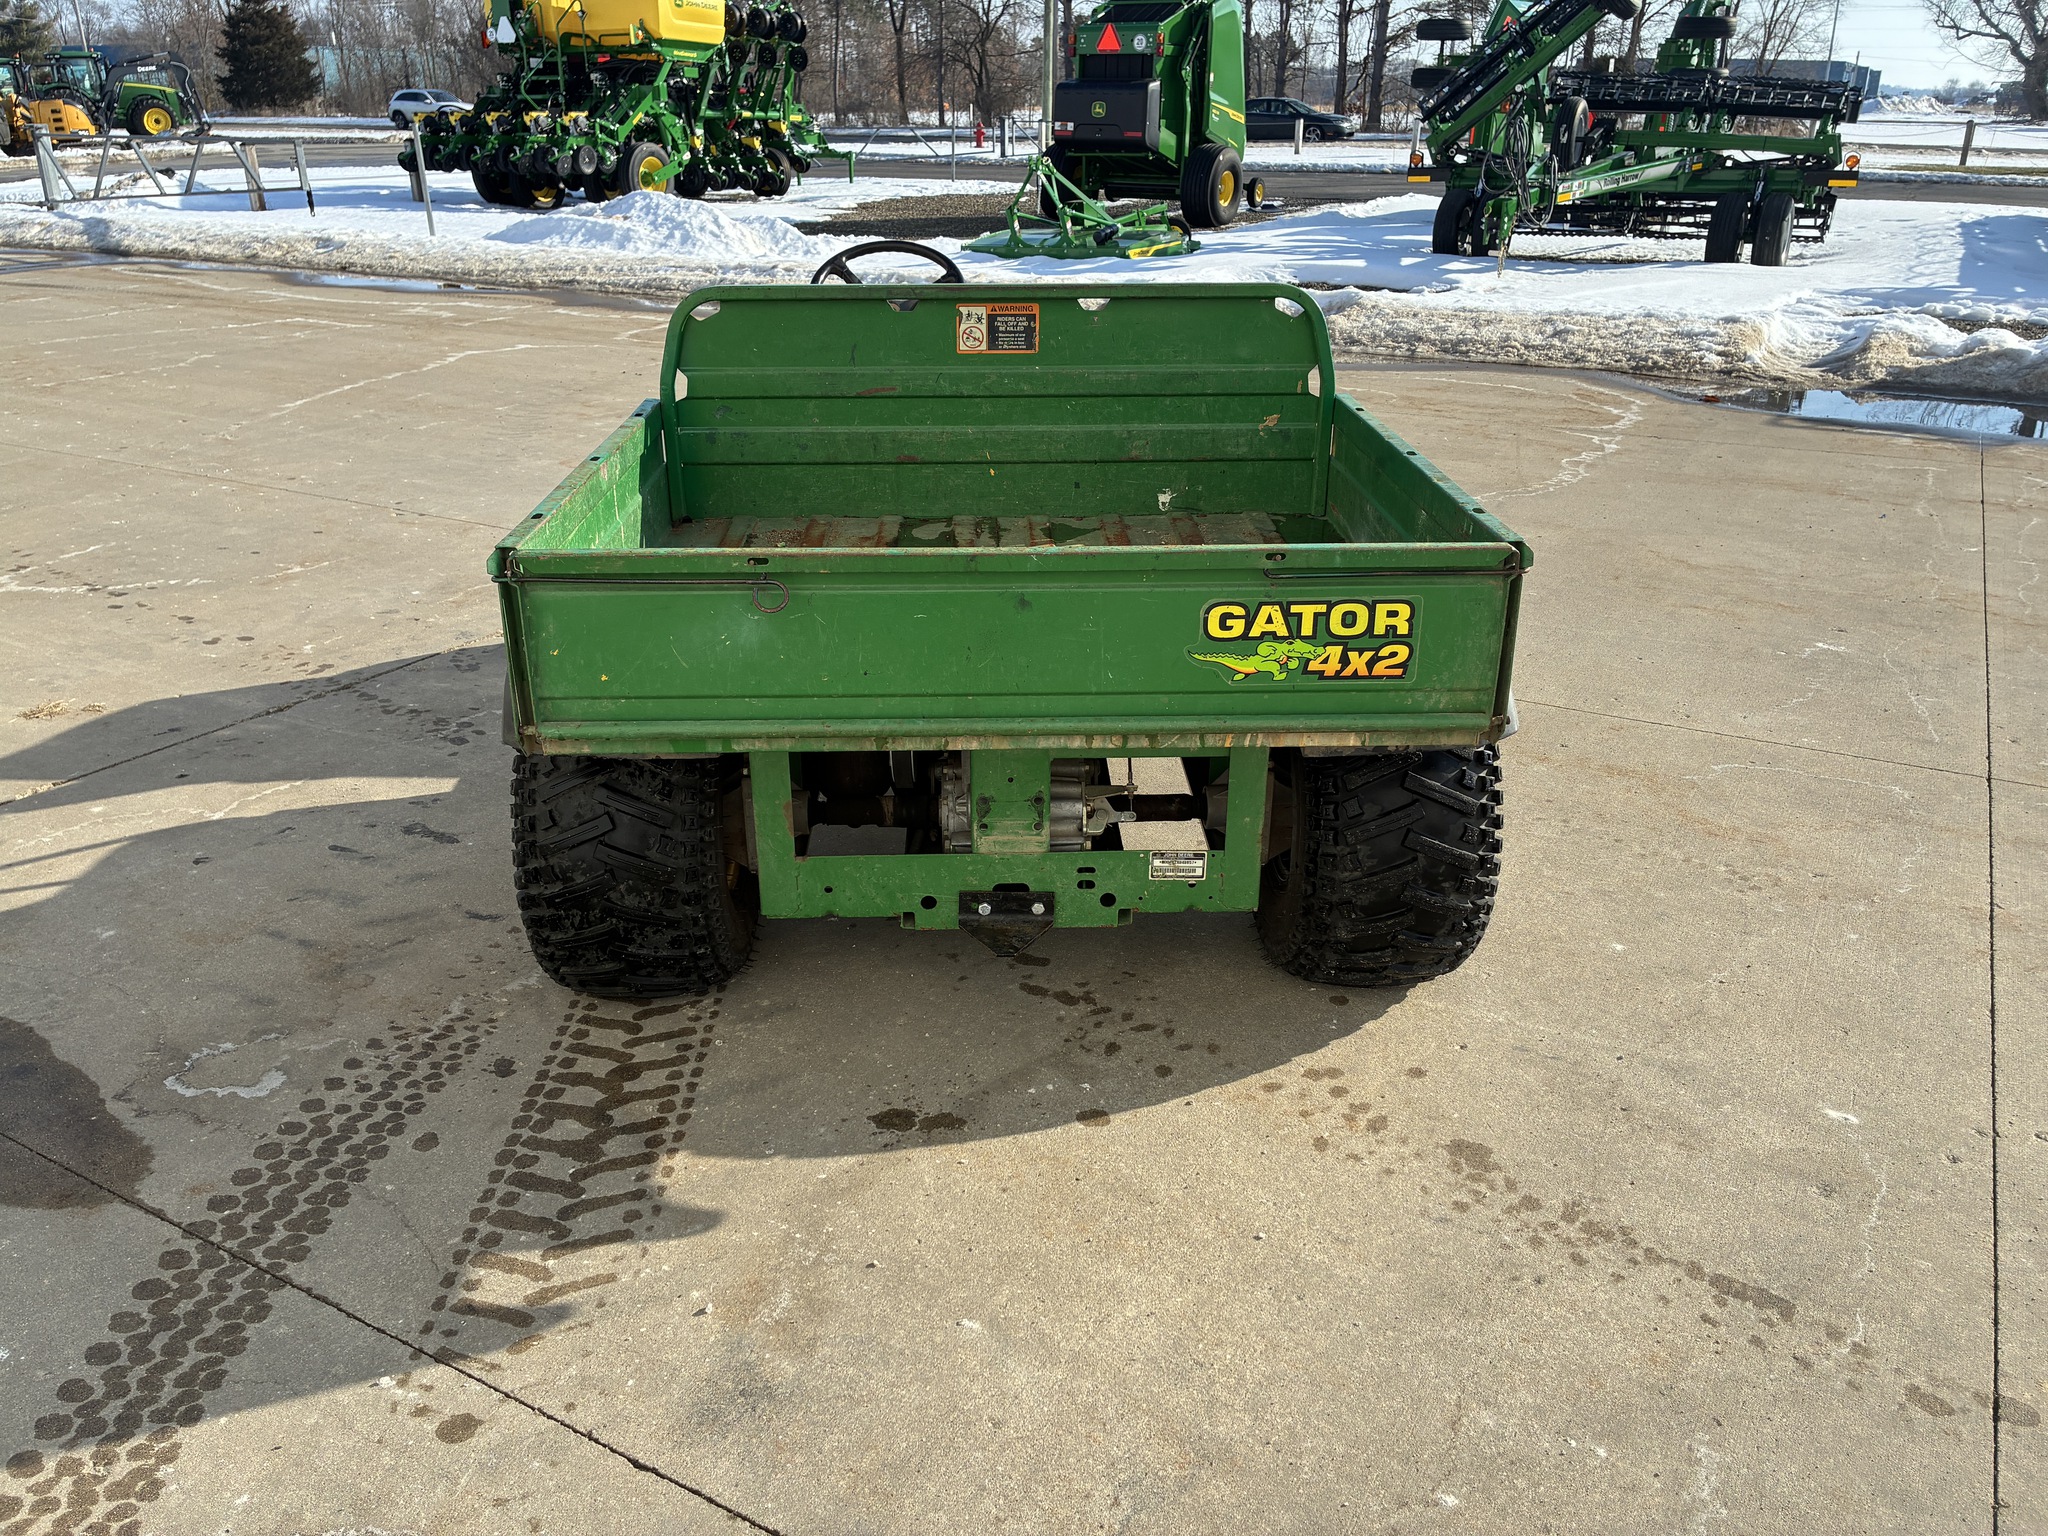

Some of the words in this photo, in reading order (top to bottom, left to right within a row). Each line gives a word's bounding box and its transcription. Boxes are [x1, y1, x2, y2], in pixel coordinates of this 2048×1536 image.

[1603, 176, 1621, 187] Rolling
[1621, 172, 1639, 183] Harrow
[1205, 602, 1412, 639] GATOR
[1305, 643, 1411, 678] 4x2
